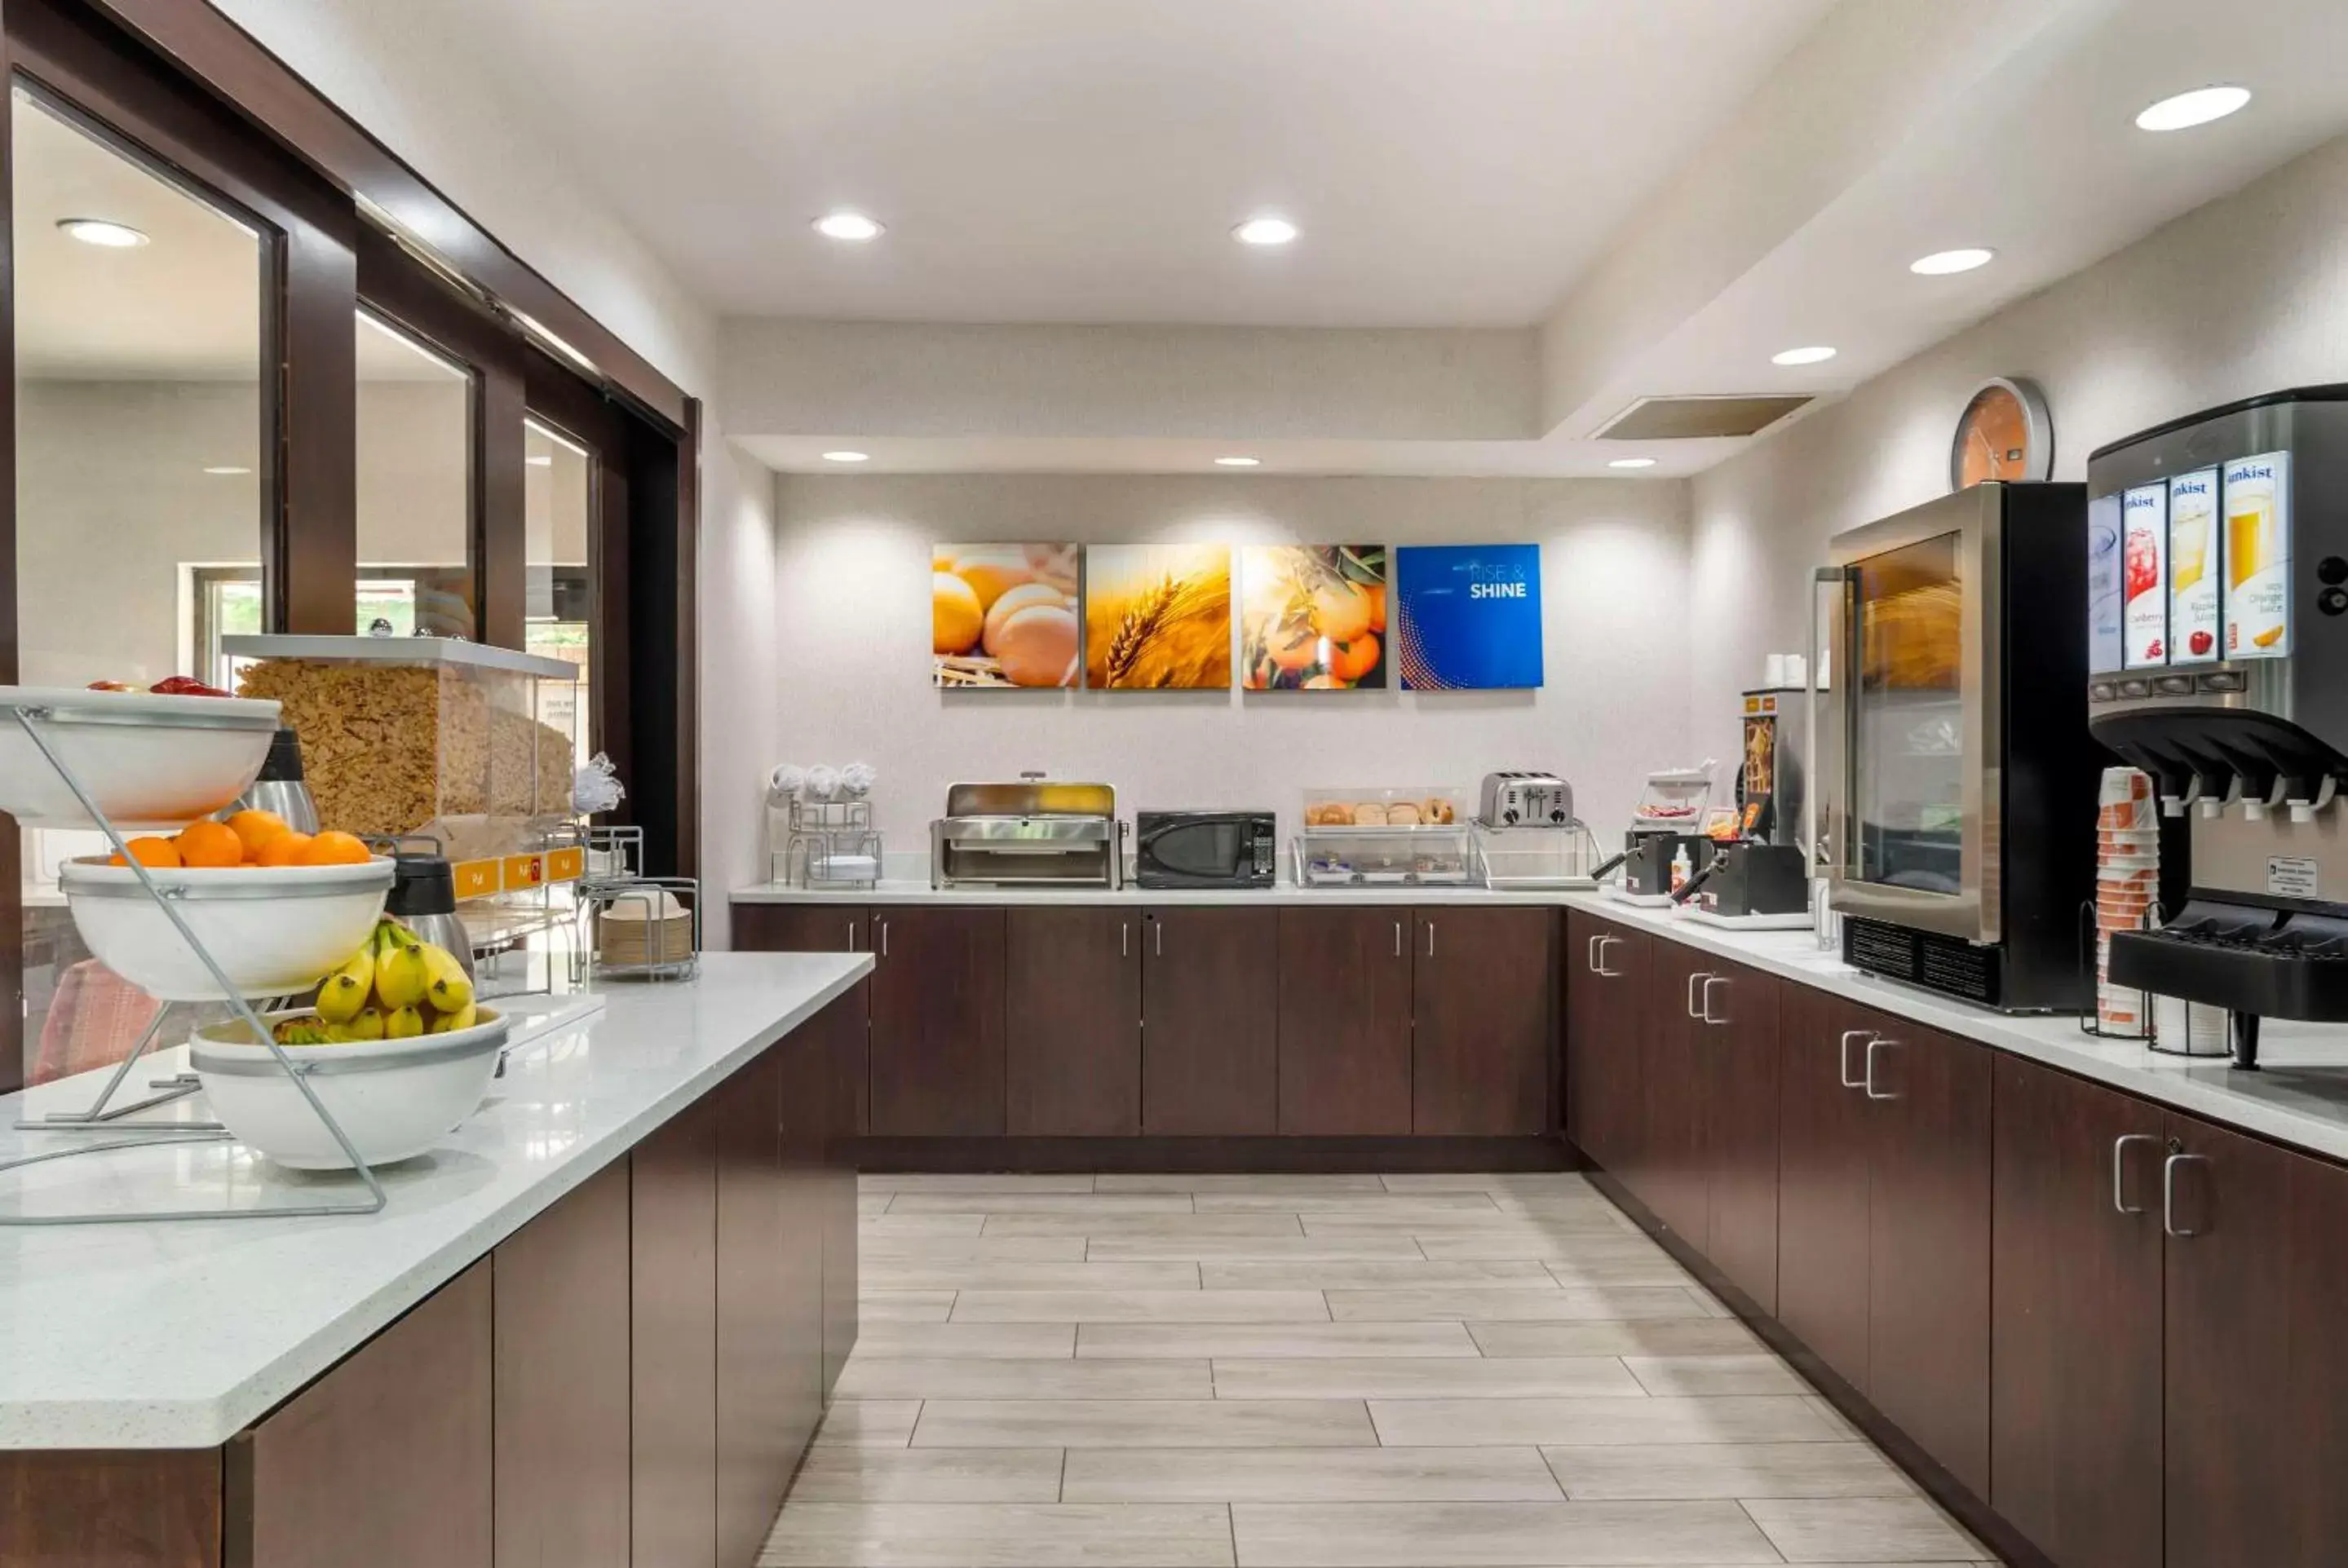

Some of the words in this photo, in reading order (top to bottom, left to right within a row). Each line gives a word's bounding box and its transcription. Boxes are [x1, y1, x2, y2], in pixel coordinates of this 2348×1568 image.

[1470, 563, 1507, 581] RISE
[1514, 563, 1526, 581] &
[1470, 582, 1527, 598] SHINE
